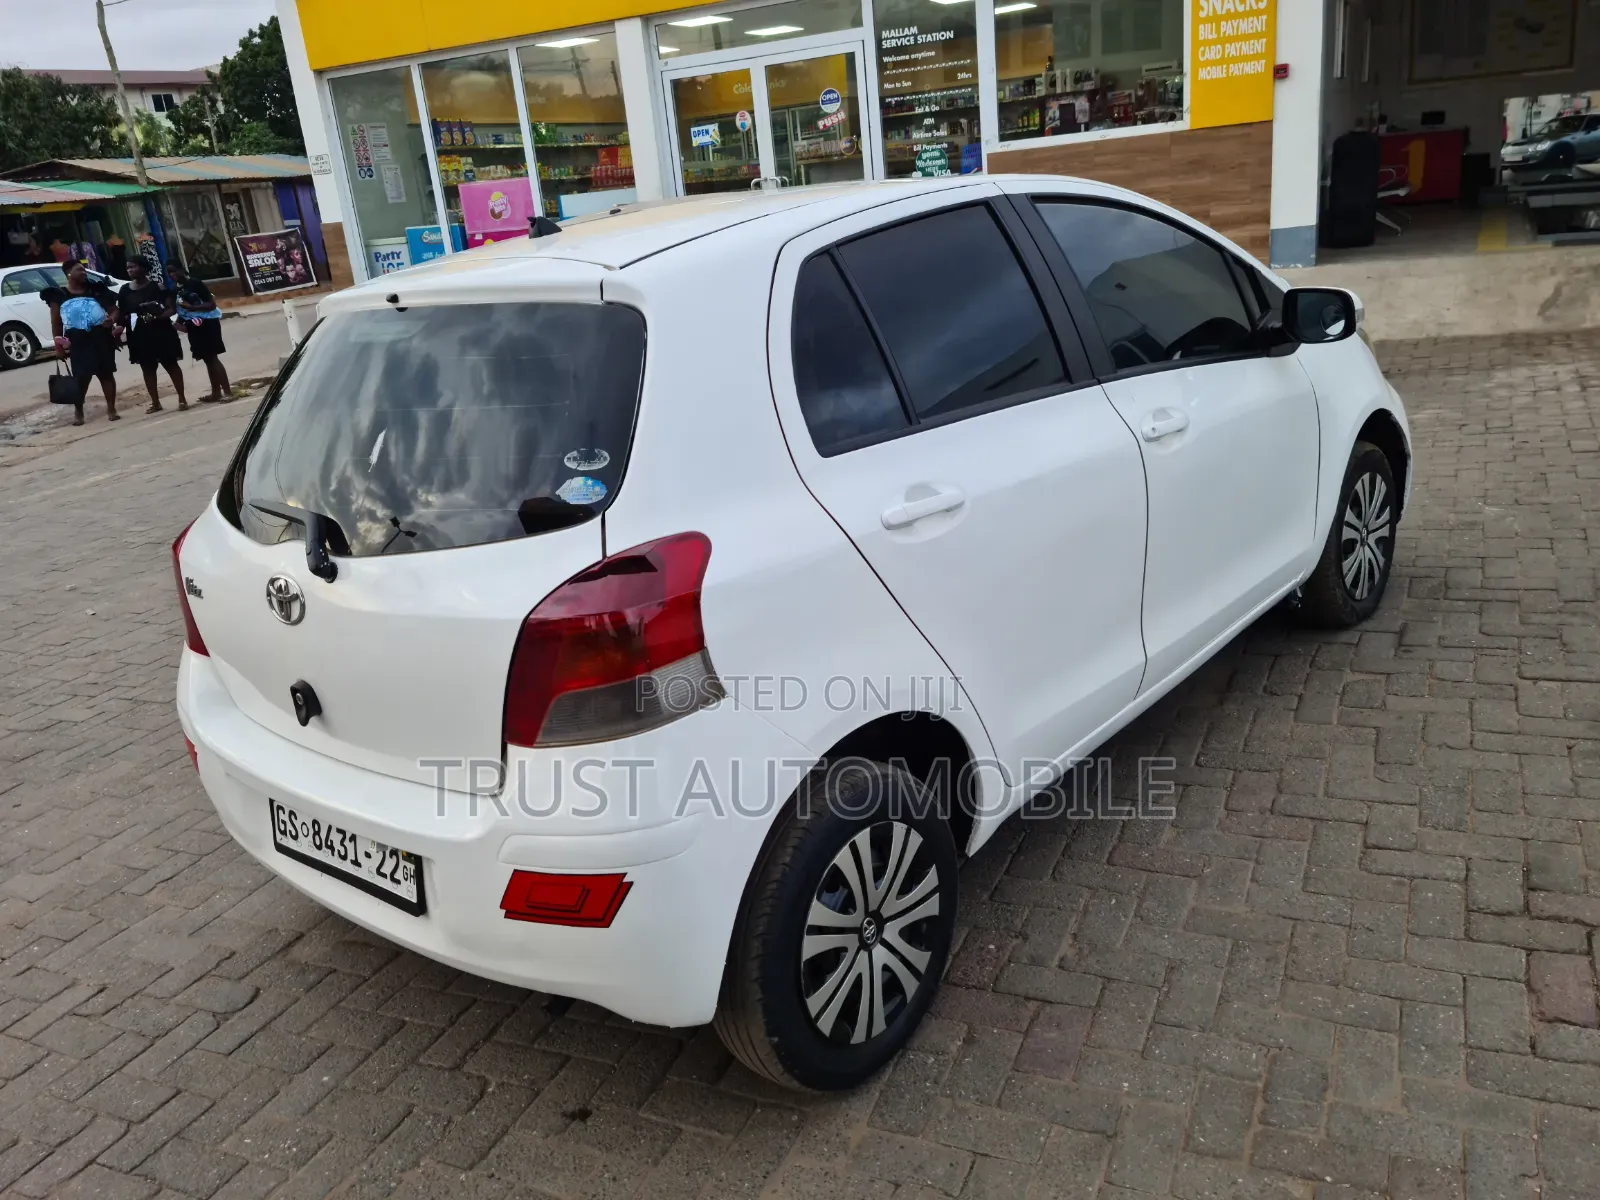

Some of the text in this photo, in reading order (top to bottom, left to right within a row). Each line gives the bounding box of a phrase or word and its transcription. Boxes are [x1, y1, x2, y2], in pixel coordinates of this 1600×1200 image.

[882, 26, 918, 38] MALLAM
[1198, 15, 1267, 41] BILL PAYMENT
[881, 30, 954, 49] SERVICE STATION
[882, 50, 936, 63] Welcome anytime
[1198, 38, 1267, 61] CARD PAYMENT
[1198, 60, 1266, 81] MOBILE PAYMENT
[821, 93, 838, 101] OPEN
[818, 111, 846, 130] PUSH
[692, 129, 710, 138] OPEN
[933, 169, 952, 177] VISA
[374, 250, 402, 262] Party
[275, 804, 402, 885] GS 8431-22
[402, 864, 416, 886] GH
